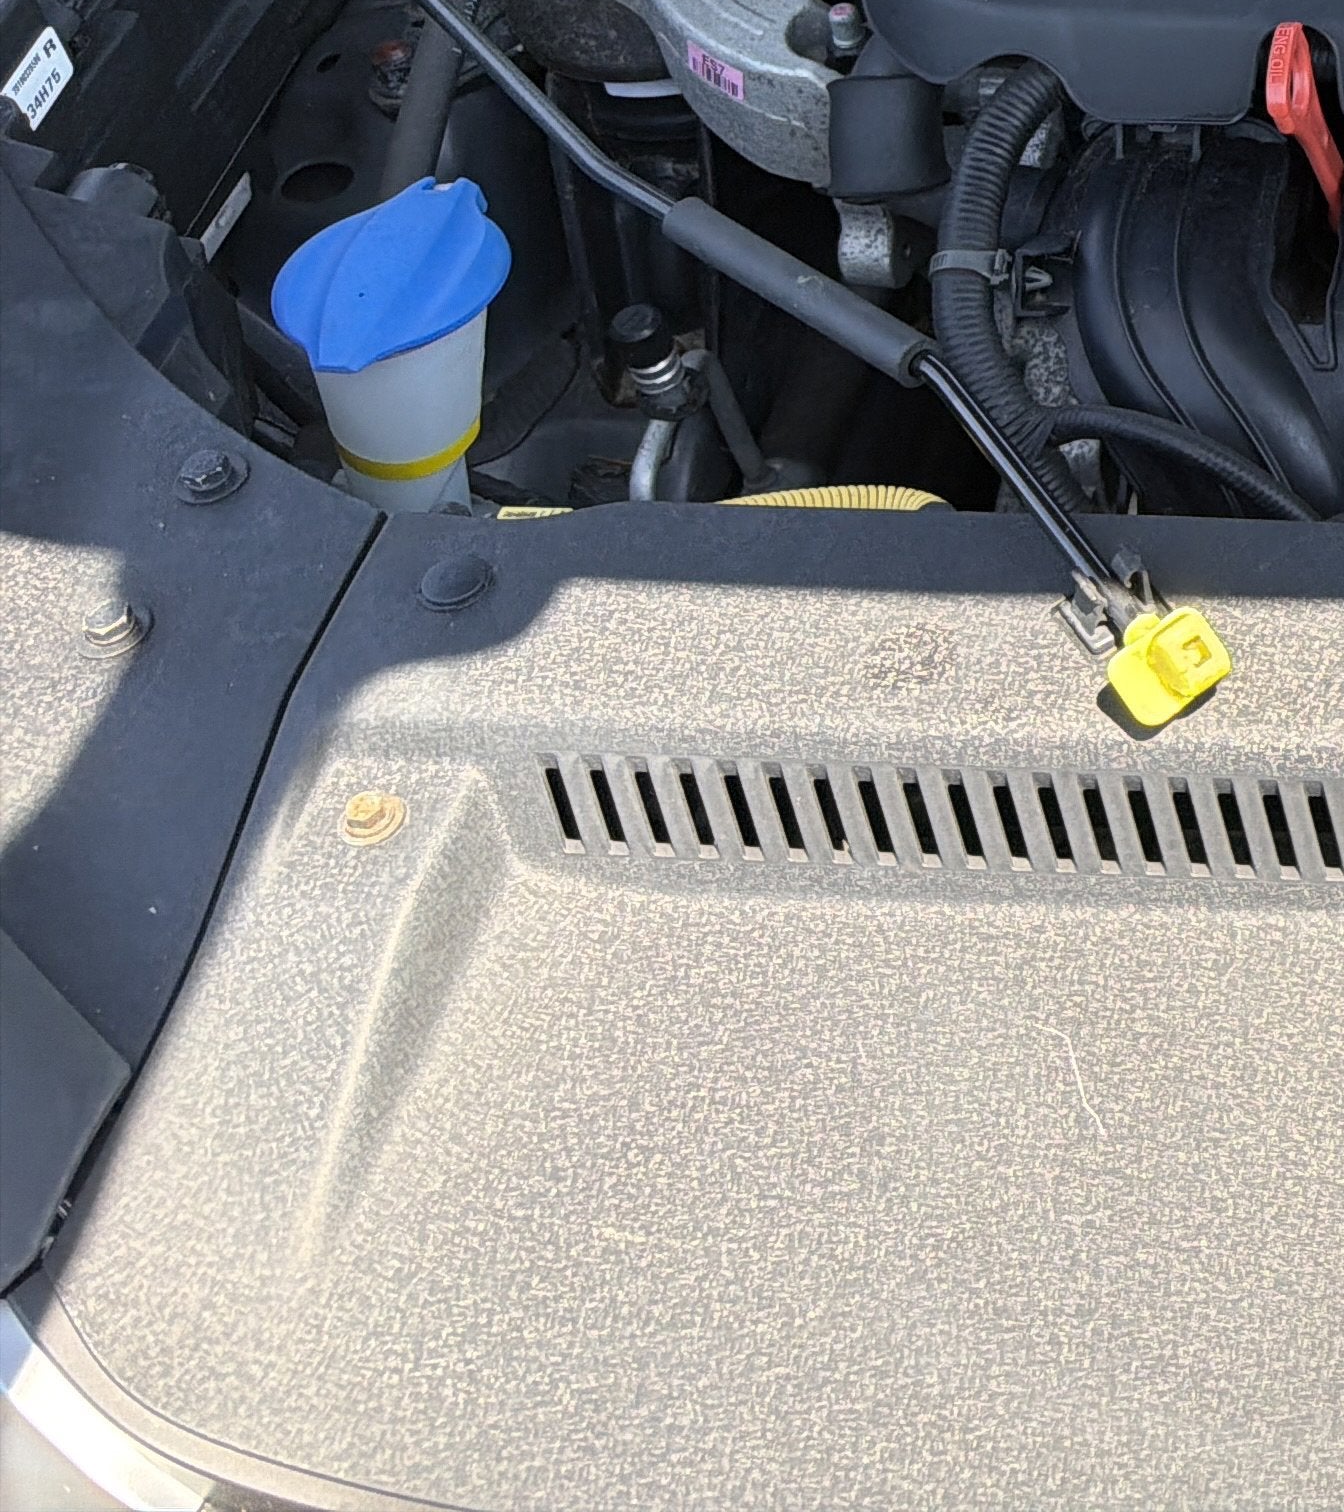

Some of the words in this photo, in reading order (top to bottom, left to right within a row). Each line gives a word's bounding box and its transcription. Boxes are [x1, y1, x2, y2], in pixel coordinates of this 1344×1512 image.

[43, 38, 57, 59] R
[1273, 27, 1290, 54] ENG
[1270, 58, 1284, 84] OIL
[27, 68, 61, 120] 34H75
